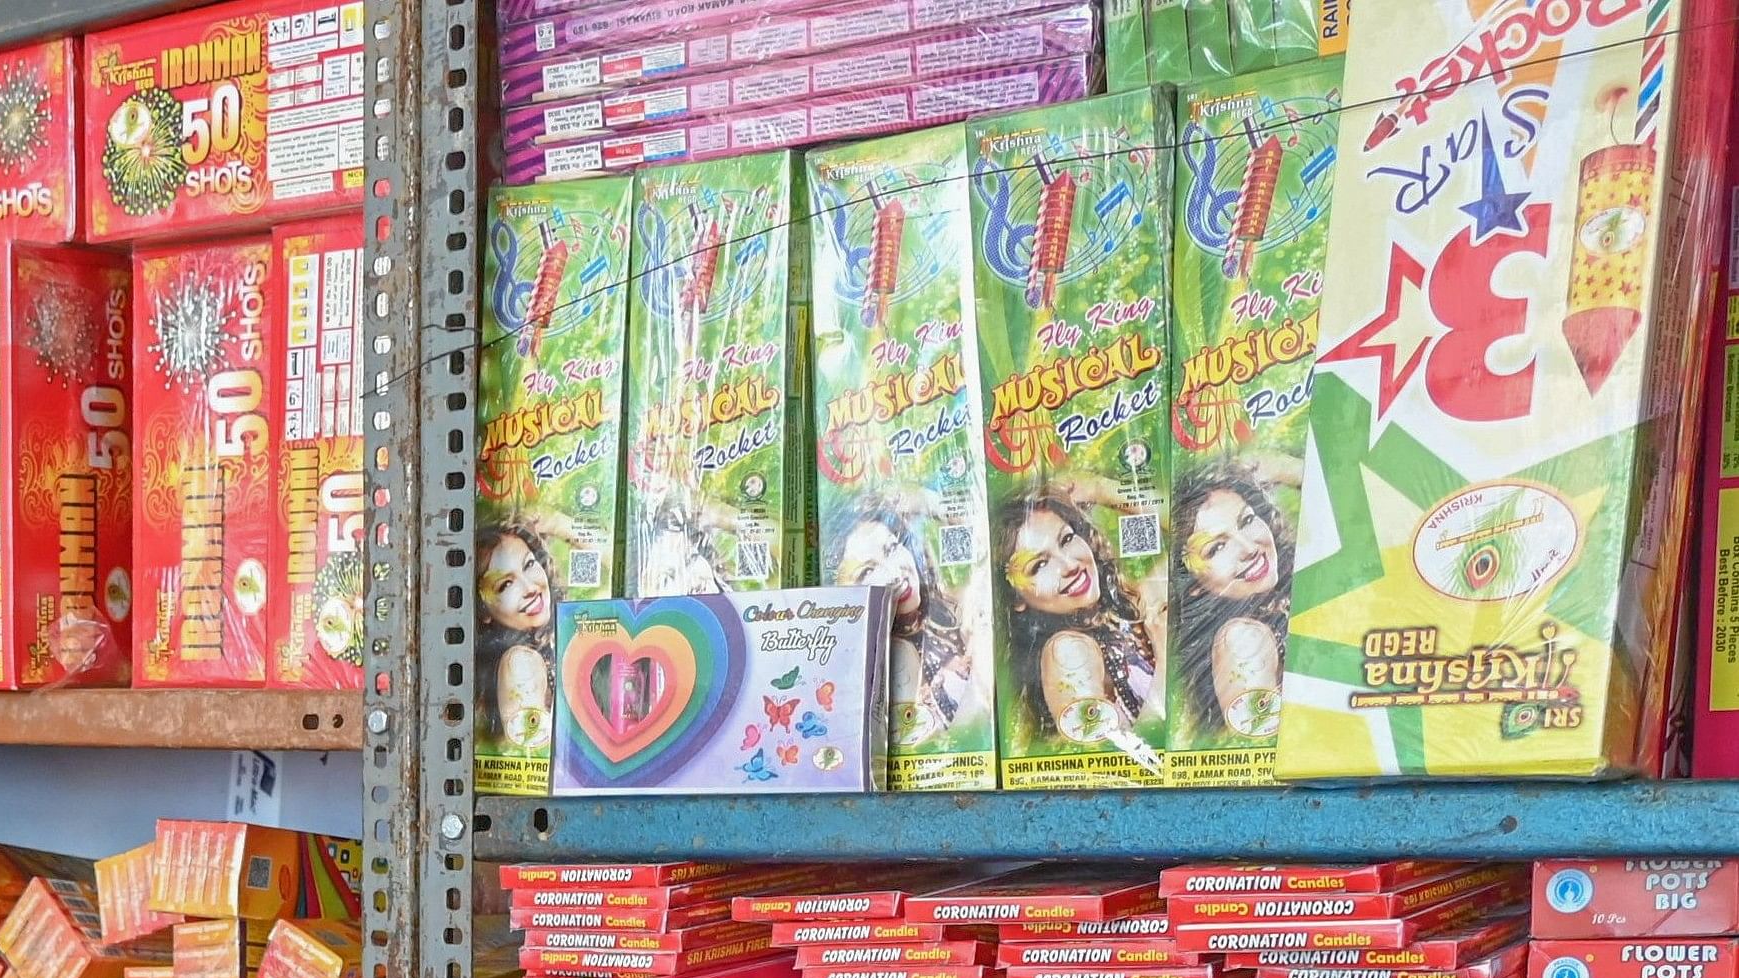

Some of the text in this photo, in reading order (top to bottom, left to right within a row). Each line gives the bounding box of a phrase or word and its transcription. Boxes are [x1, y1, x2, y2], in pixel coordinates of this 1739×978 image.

[161, 33, 262, 90] IRONMAN
[182, 83, 242, 165] 50
[1198, 95, 1254, 120] Krishna
[988, 132, 1043, 153] Krishna
[185, 160, 255, 198] SHOTS
[1037, 298, 1156, 352] Fly King
[1230, 292, 1276, 325] Fly
[1425, 203, 1552, 421] 3
[682, 343, 779, 385] Fly King
[871, 341, 910, 369] Fly
[523, 356, 615, 396] Fly King
[989, 333, 1161, 433] MUSICAL
[81, 386, 130, 470] 50
[481, 388, 608, 462] MUSICAL
[1057, 379, 1158, 450] Rocket
[179, 262, 269, 662] IRONMAN 50 SHOTS
[533, 434, 613, 485] Rocket
[693, 421, 777, 474] Rocket
[287, 447, 320, 584] IRONMAN
[743, 600, 865, 624] Colour Changing
[1715, 548, 1730, 653] Best Before 2030
[761, 625, 837, 665] Butterfly
[1364, 628, 1436, 656] REGD
[1364, 648, 1541, 696] Krishna
[484, 759, 523, 772] KRISHNA
[1008, 757, 1085, 775] SHRI KRISHNA
[1170, 753, 1252, 768] SHRI KRISHNA
[533, 892, 648, 907] CORONATION Candles
[1187, 876, 1345, 891] CORONATION Candles
[1645, 872, 1708, 891] POTS
[1654, 892, 1697, 910] BIG
[794, 922, 919, 941] CORONATION Candles
[1621, 945, 1718, 964] FLOWER
